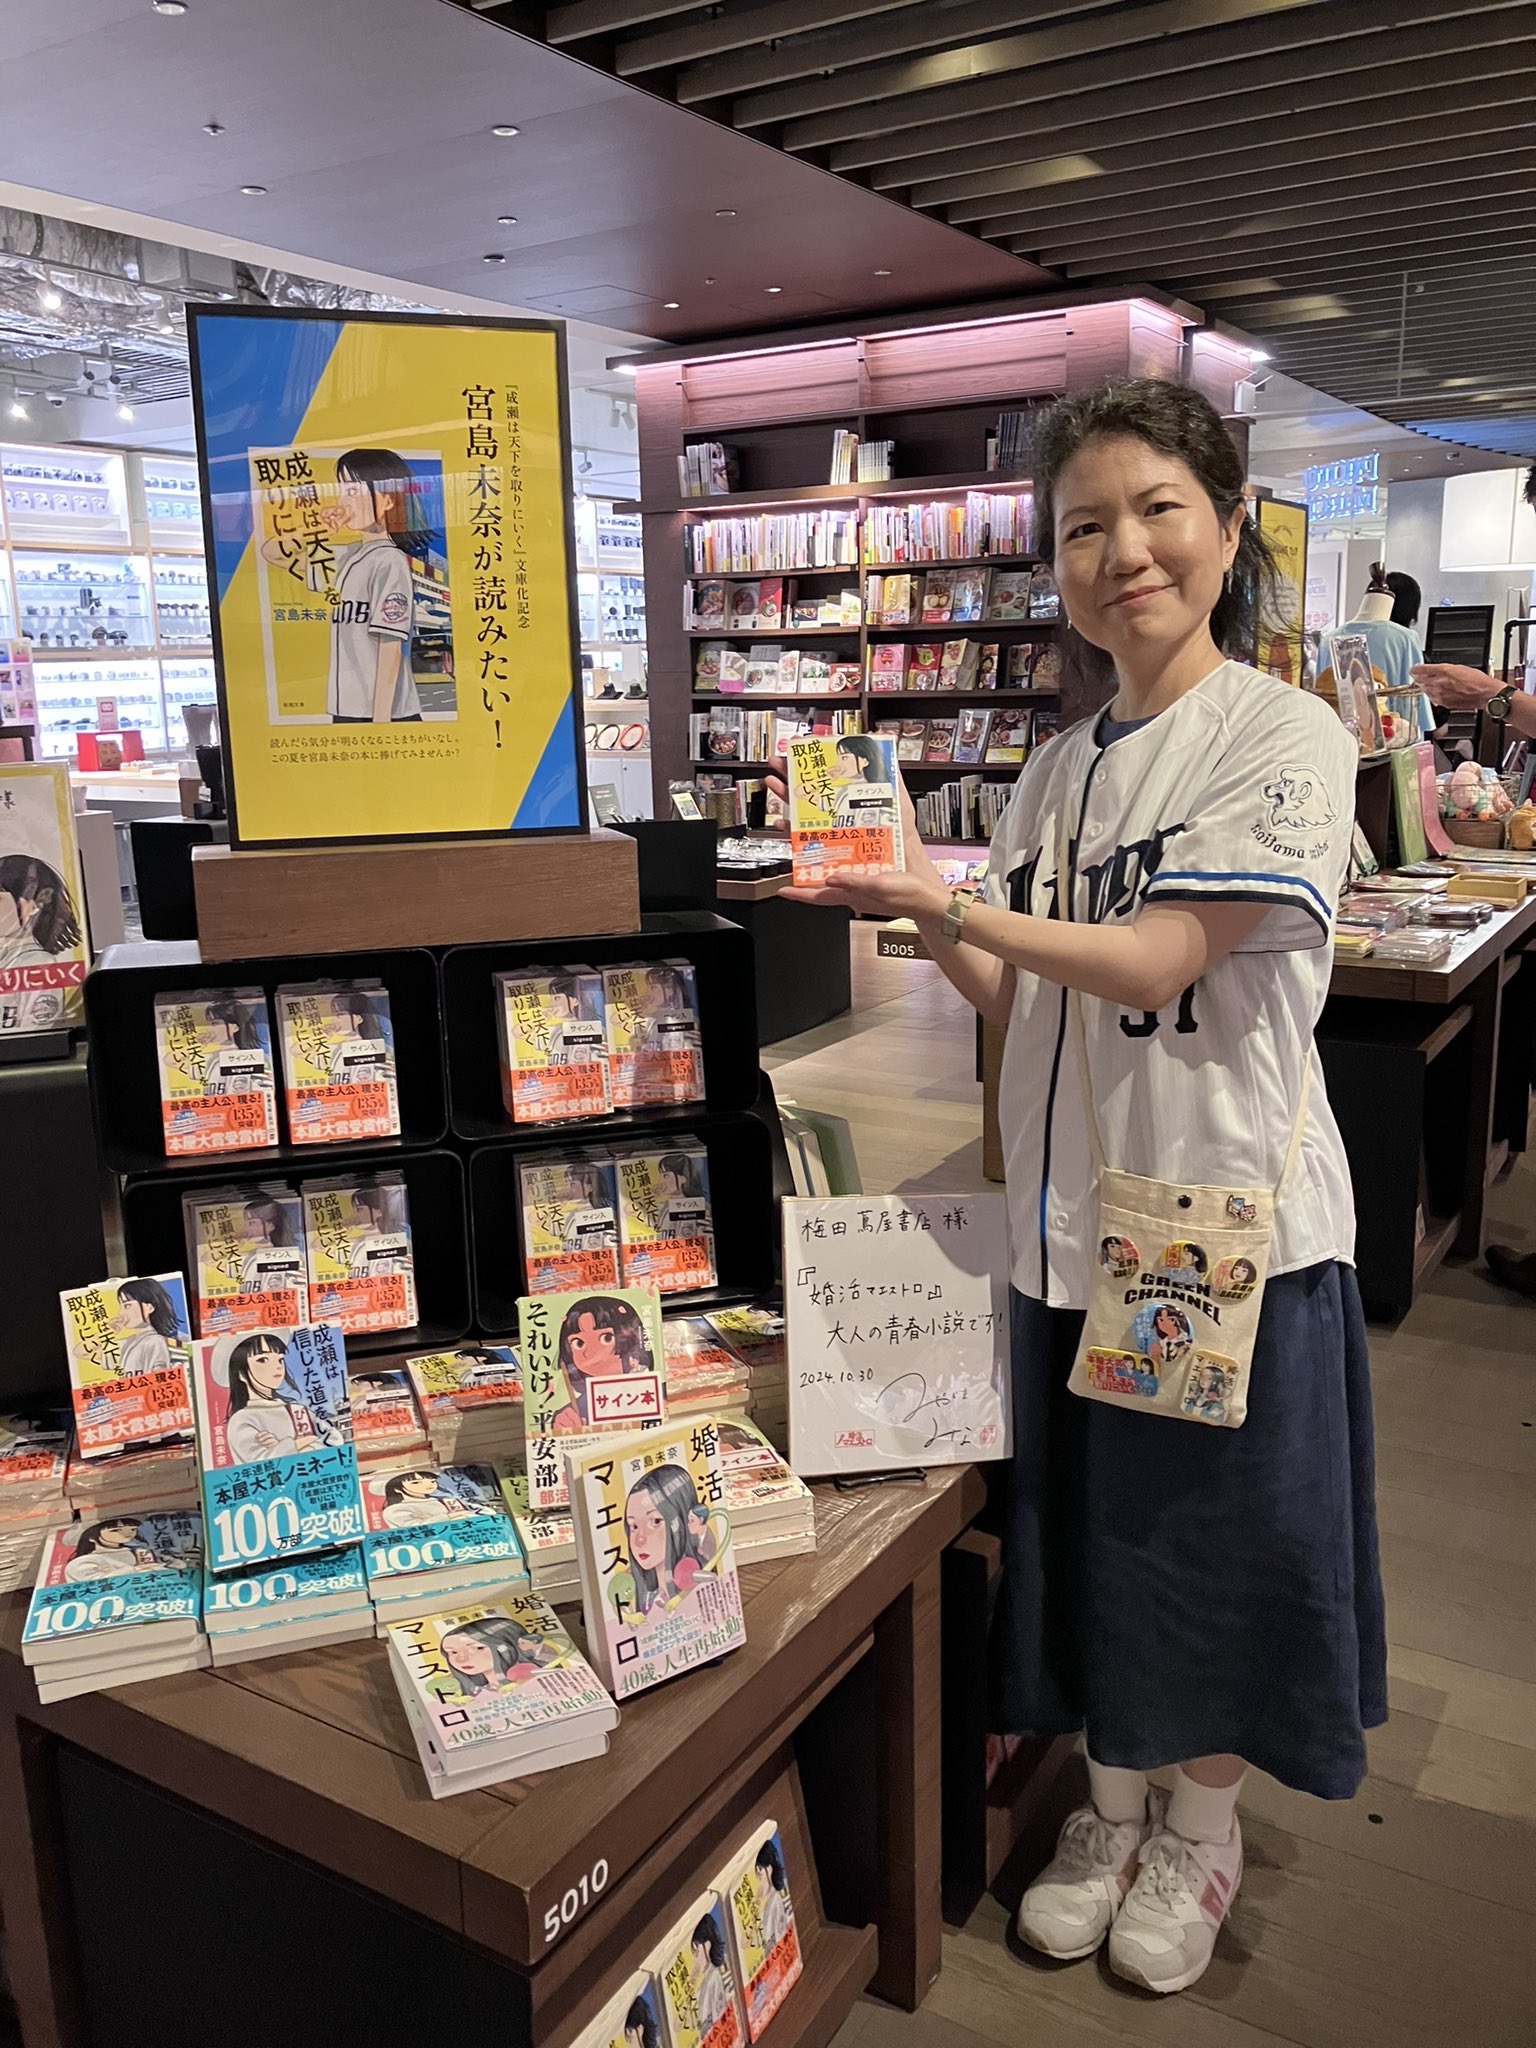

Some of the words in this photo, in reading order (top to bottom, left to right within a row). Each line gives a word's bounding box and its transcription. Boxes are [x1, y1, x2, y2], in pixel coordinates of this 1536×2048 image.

[255, 458, 304, 581] 取りにいく
[286, 451, 340, 605] 成瀬は天下を
[505, 384, 530, 629] 『成瀬は天下を取りにいく』文庫化記念
[273, 608, 327, 621] 宮島未奈
[270, 733, 459, 749] 読んだら気分が明るくなることまちがいなし。
[791, 744, 817, 807] 取りにいく
[808, 739, 838, 819] 成瀬は天下を
[799, 828, 890, 841] 最高の主人公、現る!
[883, 943, 914, 956] 3005
[287, 1002, 314, 1066] 取りにいく
[508, 985, 534, 1046] 取りにいく
[523, 981, 552, 1056] 成瀬は天下を
[608, 974, 631, 1034] 取りにいく
[160, 1010, 188, 1075] 取りにいく
[176, 1005, 209, 1087] 成瀬は天下を
[303, 996, 334, 1078] 成瀬は天下を
[168, 1130, 267, 1152] 本屋大賞受賞作
[295, 1119, 390, 1140] 本屋大賞受賞作
[525, 1173, 550, 1232] 取りにいく
[621, 1164, 644, 1223] 取りにいく
[634, 1160, 661, 1233] 成瀬は天下を
[200, 1211, 225, 1274] 取りにいく
[216, 1206, 245, 1285] 成瀬は天下を
[309, 1198, 335, 1259] 取りにいく
[324, 1193, 353, 1271] 成瀬は天下を
[801, 1218, 847, 1242] 梅田
[943, 1207, 968, 1231] 様
[797, 1266, 943, 1306] 『婚活マエストロ』
[1124, 1289, 1222, 1326] CHANNEL
[1140, 1272, 1211, 1297] GREEN
[66, 1297, 101, 1365] 取りにいく
[86, 1289, 126, 1377] 成瀬は天下を
[312, 1323, 340, 1380] 成瀬は
[826, 1310, 1004, 1349] 大人の青春小説です!
[81, 1370, 182, 1400] 最高の主人公、現る!
[291, 1328, 338, 1447] 信じた道をいく
[596, 1390, 656, 1409] サイン本
[799, 1367, 874, 1388] 2024.10.30
[82, 1408, 191, 1444] 本屋大賞受賞作
[213, 1425, 227, 1465] 宮島未奈
[214, 1447, 353, 1506] 本屋大賞ノミネート!
[630, 1446, 678, 1472] 宮島未奈
[690, 1422, 723, 1504] 婚活
[588, 1460, 639, 1665] マエストロ
[511, 1593, 558, 1634] 婚活
[395, 1621, 470, 1727] マエストロ
[544, 1859, 608, 1942] 5010
